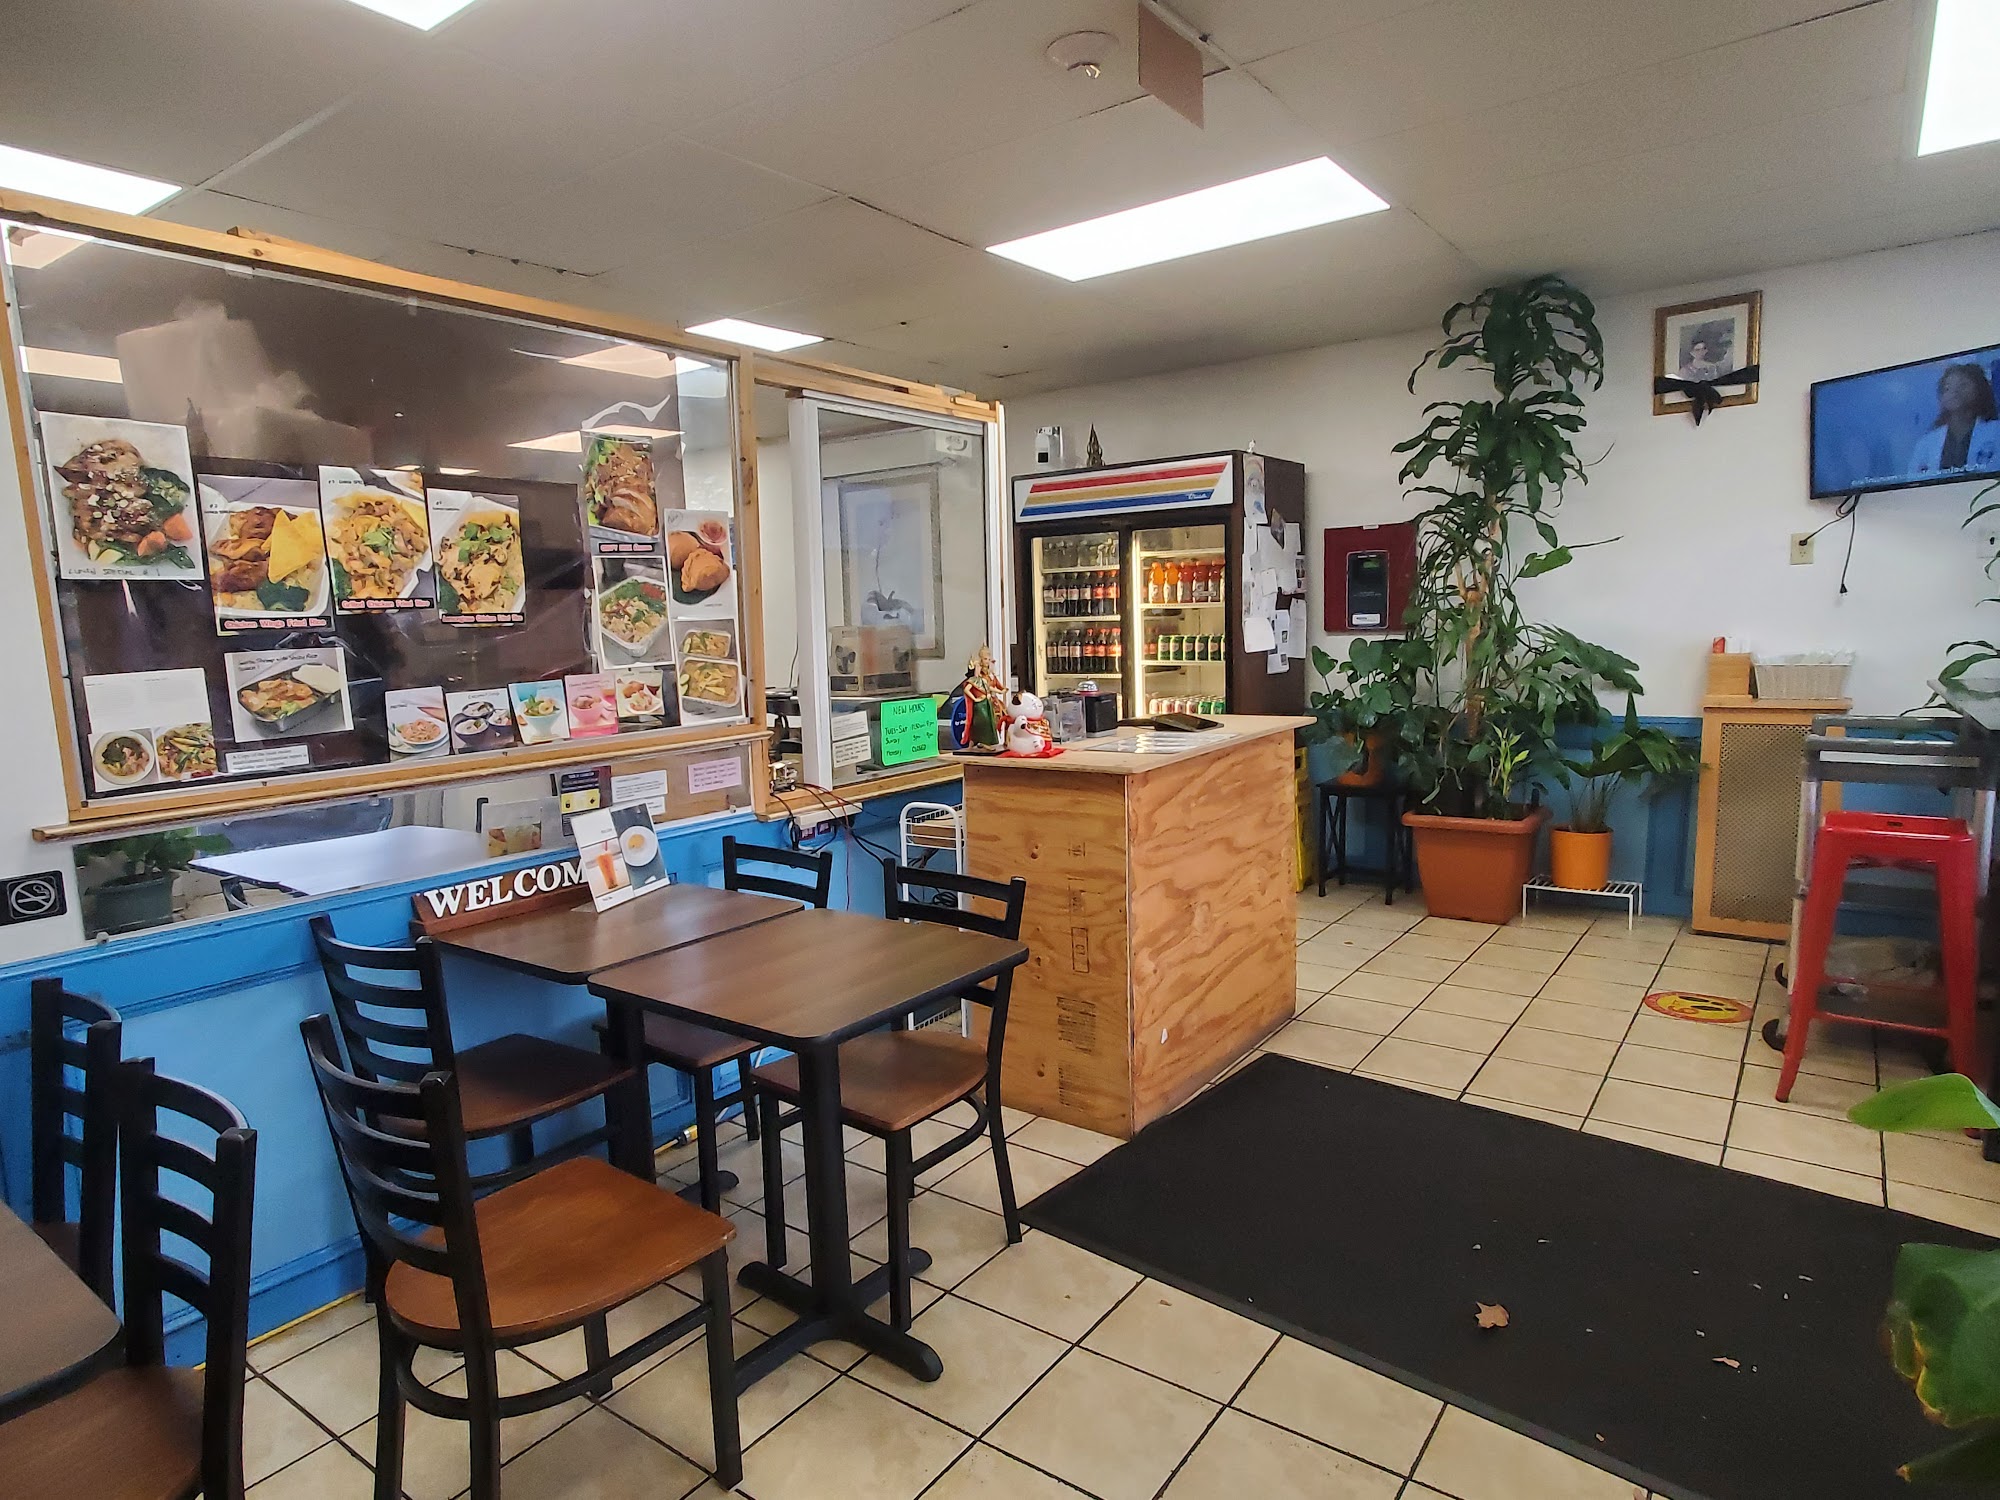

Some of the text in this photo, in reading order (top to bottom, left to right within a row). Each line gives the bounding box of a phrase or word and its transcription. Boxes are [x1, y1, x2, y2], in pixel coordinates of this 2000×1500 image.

[366, 599, 395, 609] Chicken
[395, 599, 414, 608] Fried
[414, 598, 431, 607] Rice
[224, 617, 328, 630] Chicken Wings Fried Rice
[892, 702, 926, 716] NEW HOURS
[424, 861, 589, 919] WELCOM
